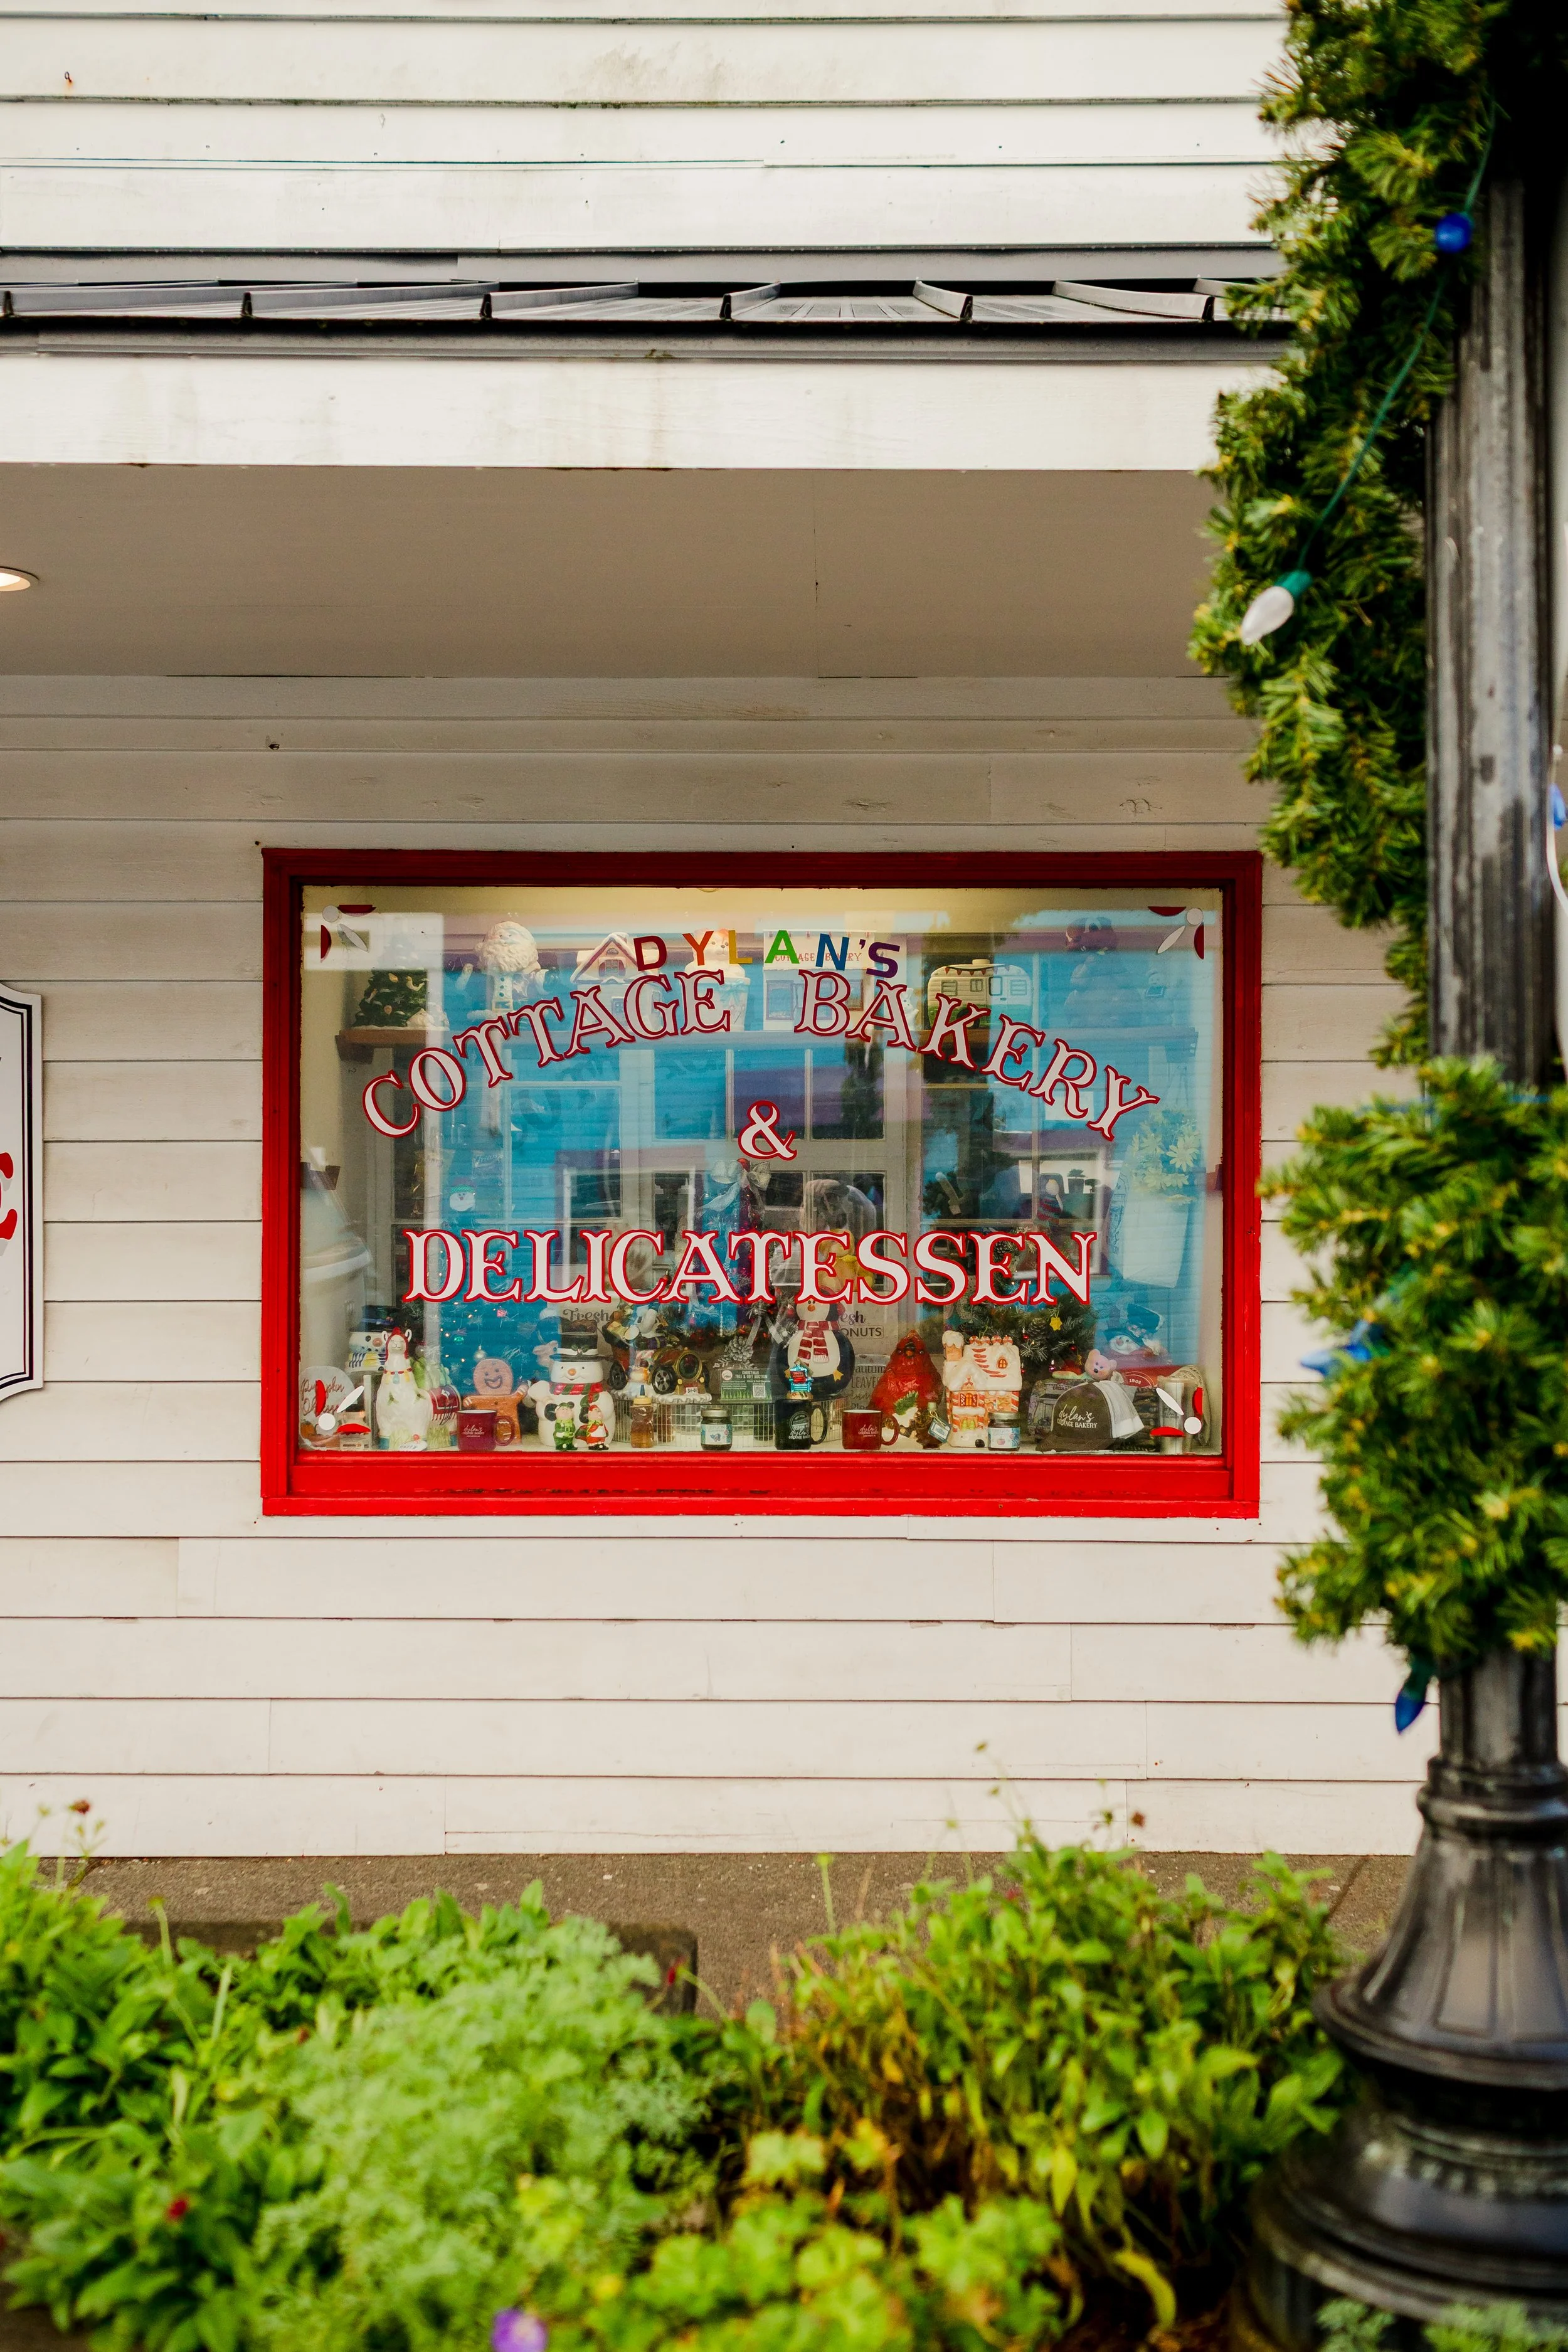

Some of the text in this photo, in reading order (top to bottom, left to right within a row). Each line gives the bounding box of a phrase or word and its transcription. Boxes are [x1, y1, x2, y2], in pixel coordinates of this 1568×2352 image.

[633, 930, 901, 978] DYLAN'S
[775, 953, 862, 961] COAGE BRY
[363, 969, 1160, 1142] COTTAGE BAKERY
[738, 1100, 797, 1160] &
[402, 1226, 1097, 1306] DELICATESSEN
[563, 1308, 610, 1323] Fresh
[840, 1310, 866, 1325] esh
[840, 1327, 882, 1337] ONUTS
[1059, 1404, 1095, 1425] dylan's
